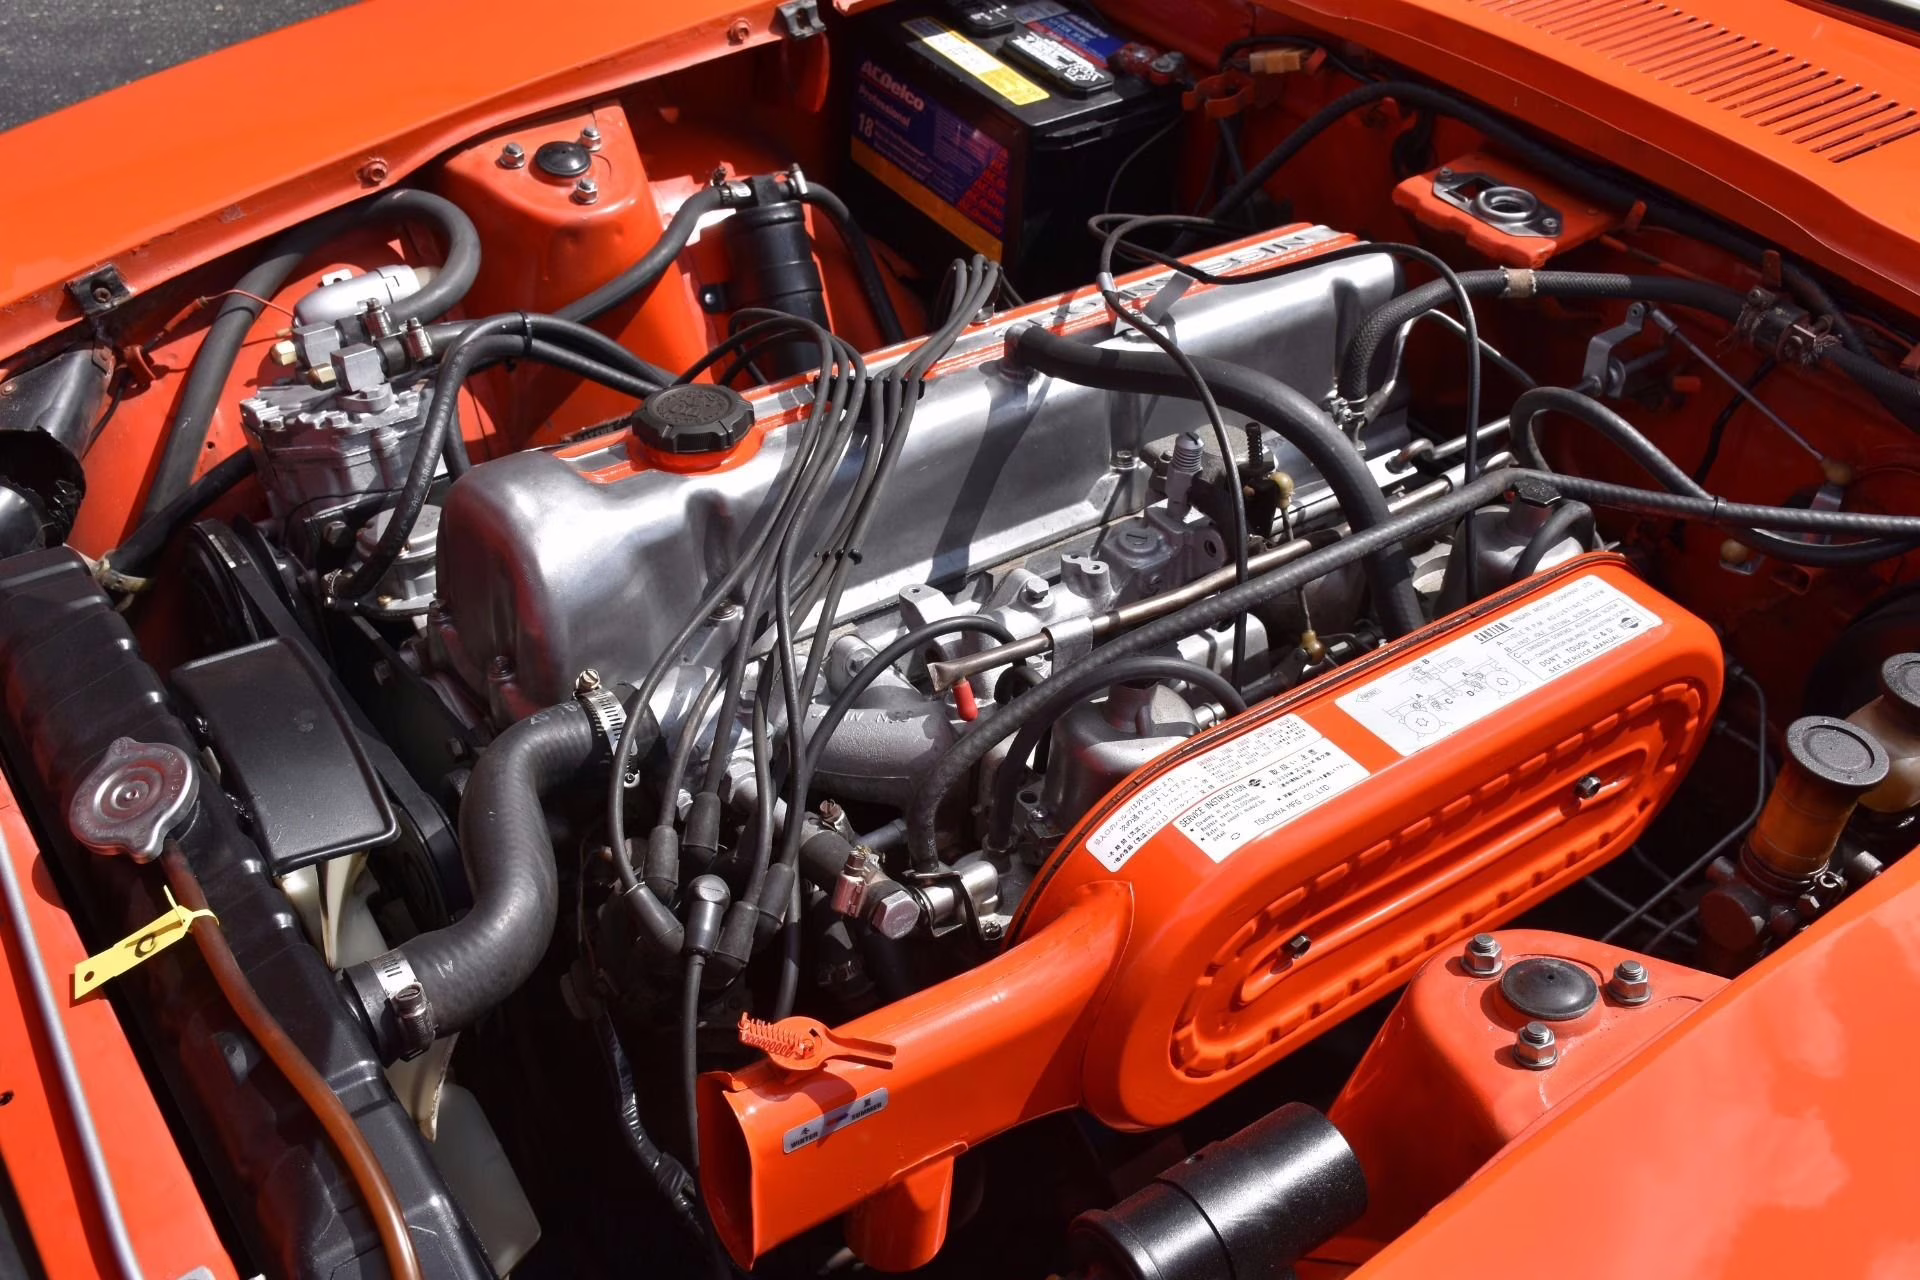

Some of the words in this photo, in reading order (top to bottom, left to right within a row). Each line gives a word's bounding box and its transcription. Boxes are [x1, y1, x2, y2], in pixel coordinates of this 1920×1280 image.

[861, 60, 925, 111] ACDelco
[1473, 622, 1510, 642] CAUTION
[1564, 639, 1590, 654] TOUCH
[1547, 662, 1566, 674] SEE
[1565, 649, 1592, 667] SERVICE
[1178, 807, 1206, 828] SERVICE
[1204, 784, 1248, 810] INSTRUCTION
[1253, 805, 1287, 827] TSUCHIYA
[1284, 798, 1302, 810] MFG
[851, 1102, 882, 1120] SUMMER
[790, 1131, 819, 1148] WINTER
